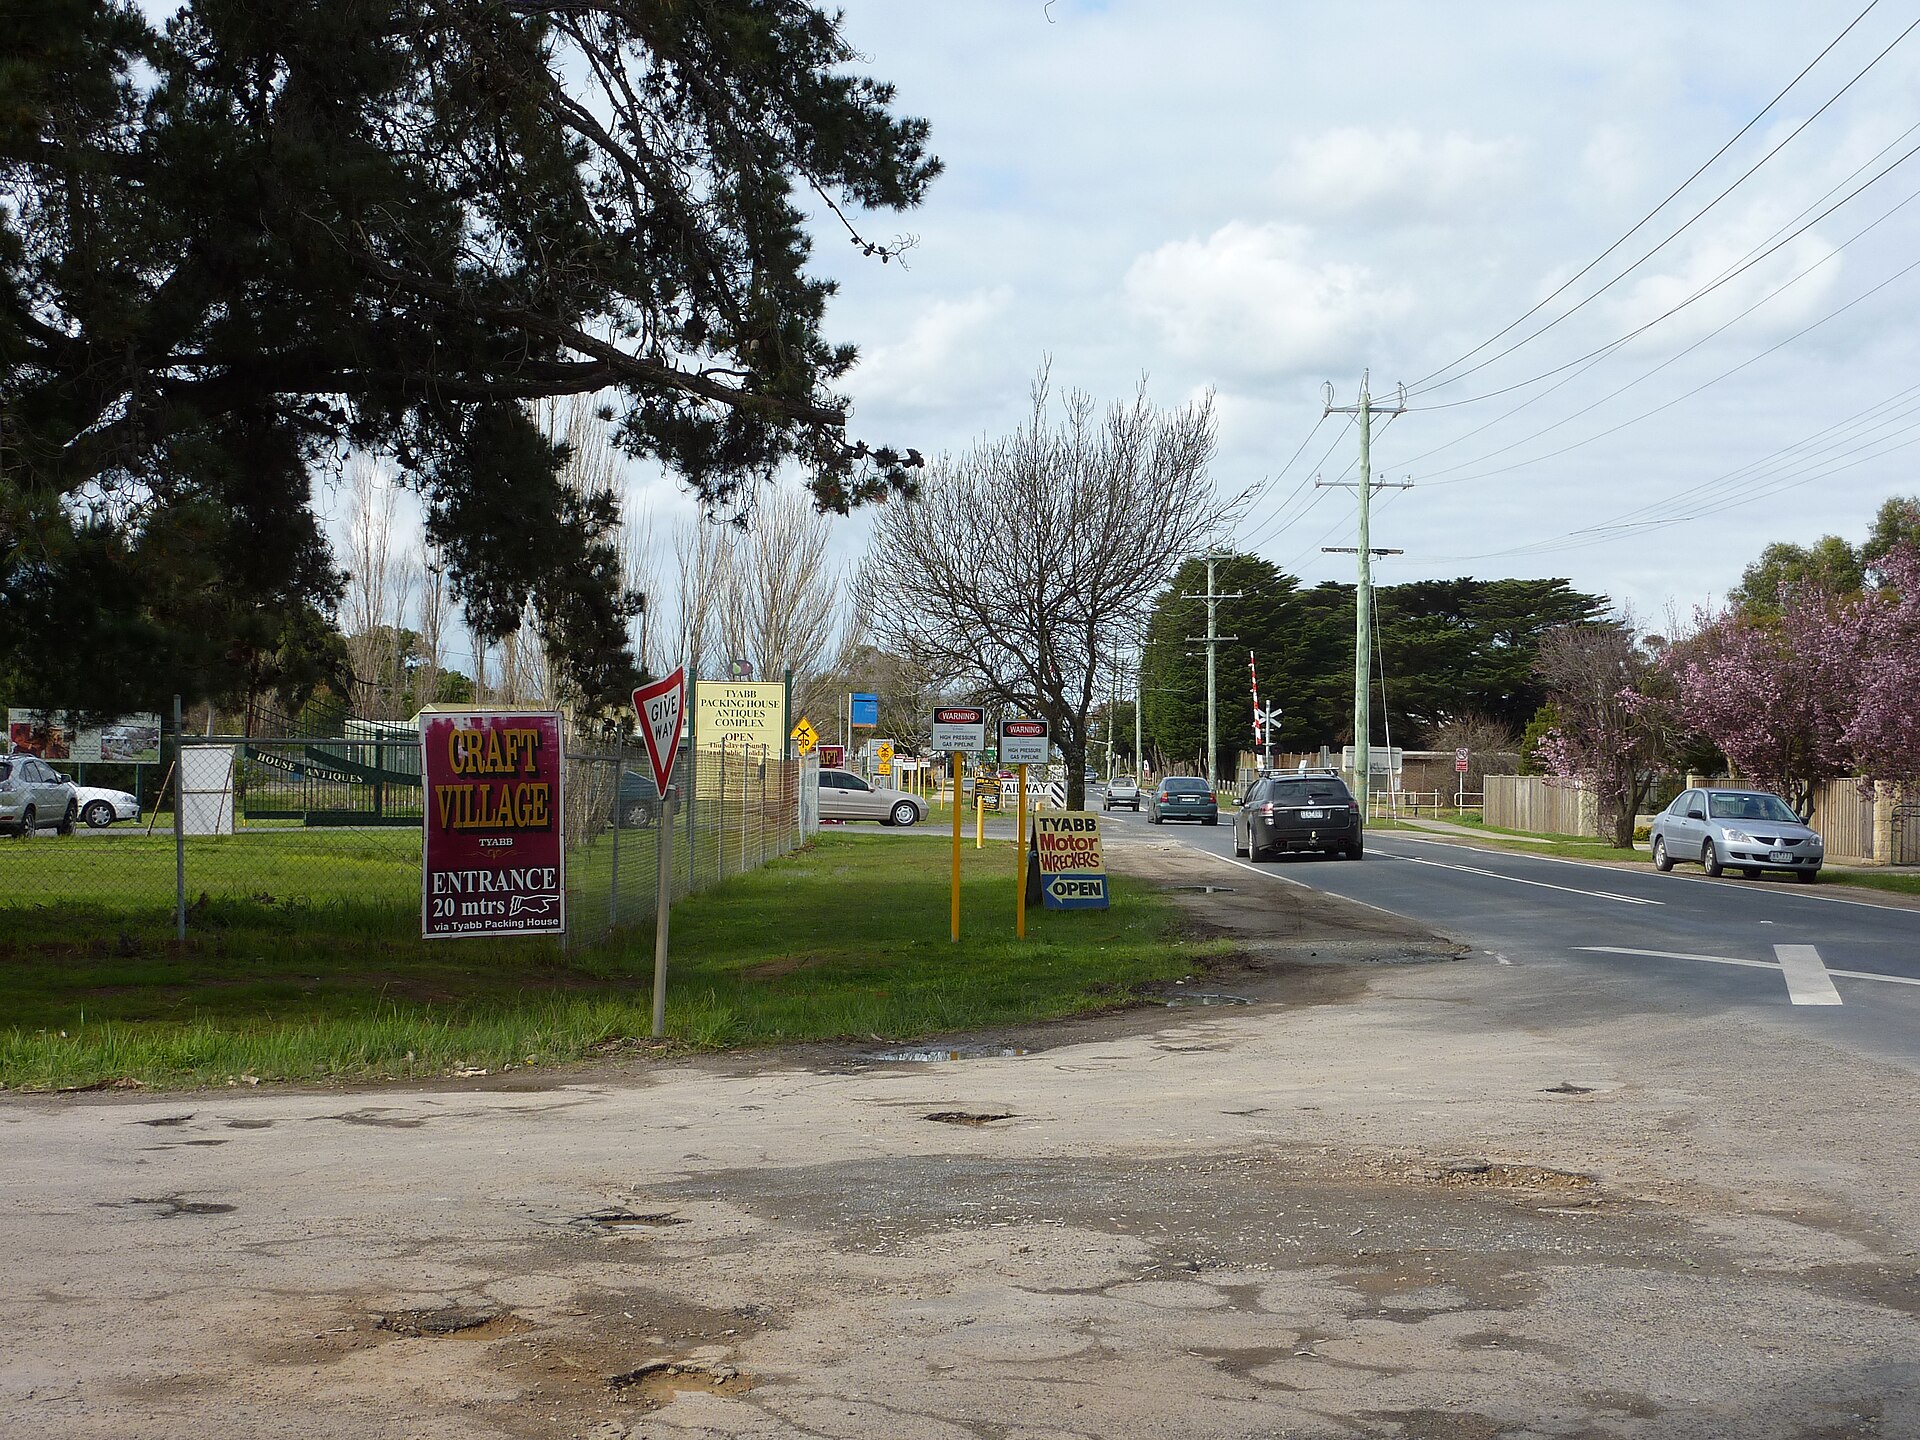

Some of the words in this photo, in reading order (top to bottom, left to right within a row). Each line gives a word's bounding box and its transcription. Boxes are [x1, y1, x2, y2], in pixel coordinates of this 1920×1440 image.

[724, 689, 757, 698] TYABB
[651, 694, 677, 722] GIVE
[701, 699, 744, 708] PACKING
[746, 700, 780, 708] HOUSE
[716, 709, 766, 718] ANTIQUES
[942, 712, 976, 720] WARNING
[655, 720, 675, 740] WAY
[715, 719, 764, 727] COMPLEX
[1010, 726, 1041, 734] WARNING
[725, 732, 754, 741] OPEN
[448, 727, 540, 775] CRAFT
[256, 752, 296, 772] HOUSE
[305, 767, 363, 784] ANTIQUES
[435, 782, 550, 829] VILLAGE
[1039, 817, 1097, 832] TYABB
[479, 838, 513, 847] TYABB
[1039, 833, 1098, 851] Motor
[1040, 851, 1100, 872] WRECKERS
[432, 867, 557, 895] ENTRANCE
[1052, 881, 1102, 896] OPEN
[432, 897, 456, 918] 20
[461, 897, 506, 917] mtrs
[434, 922, 449, 931] via
[451, 920, 483, 932] Tyabb
[485, 918, 525, 930] Packing
[526, 917, 559, 927] House
